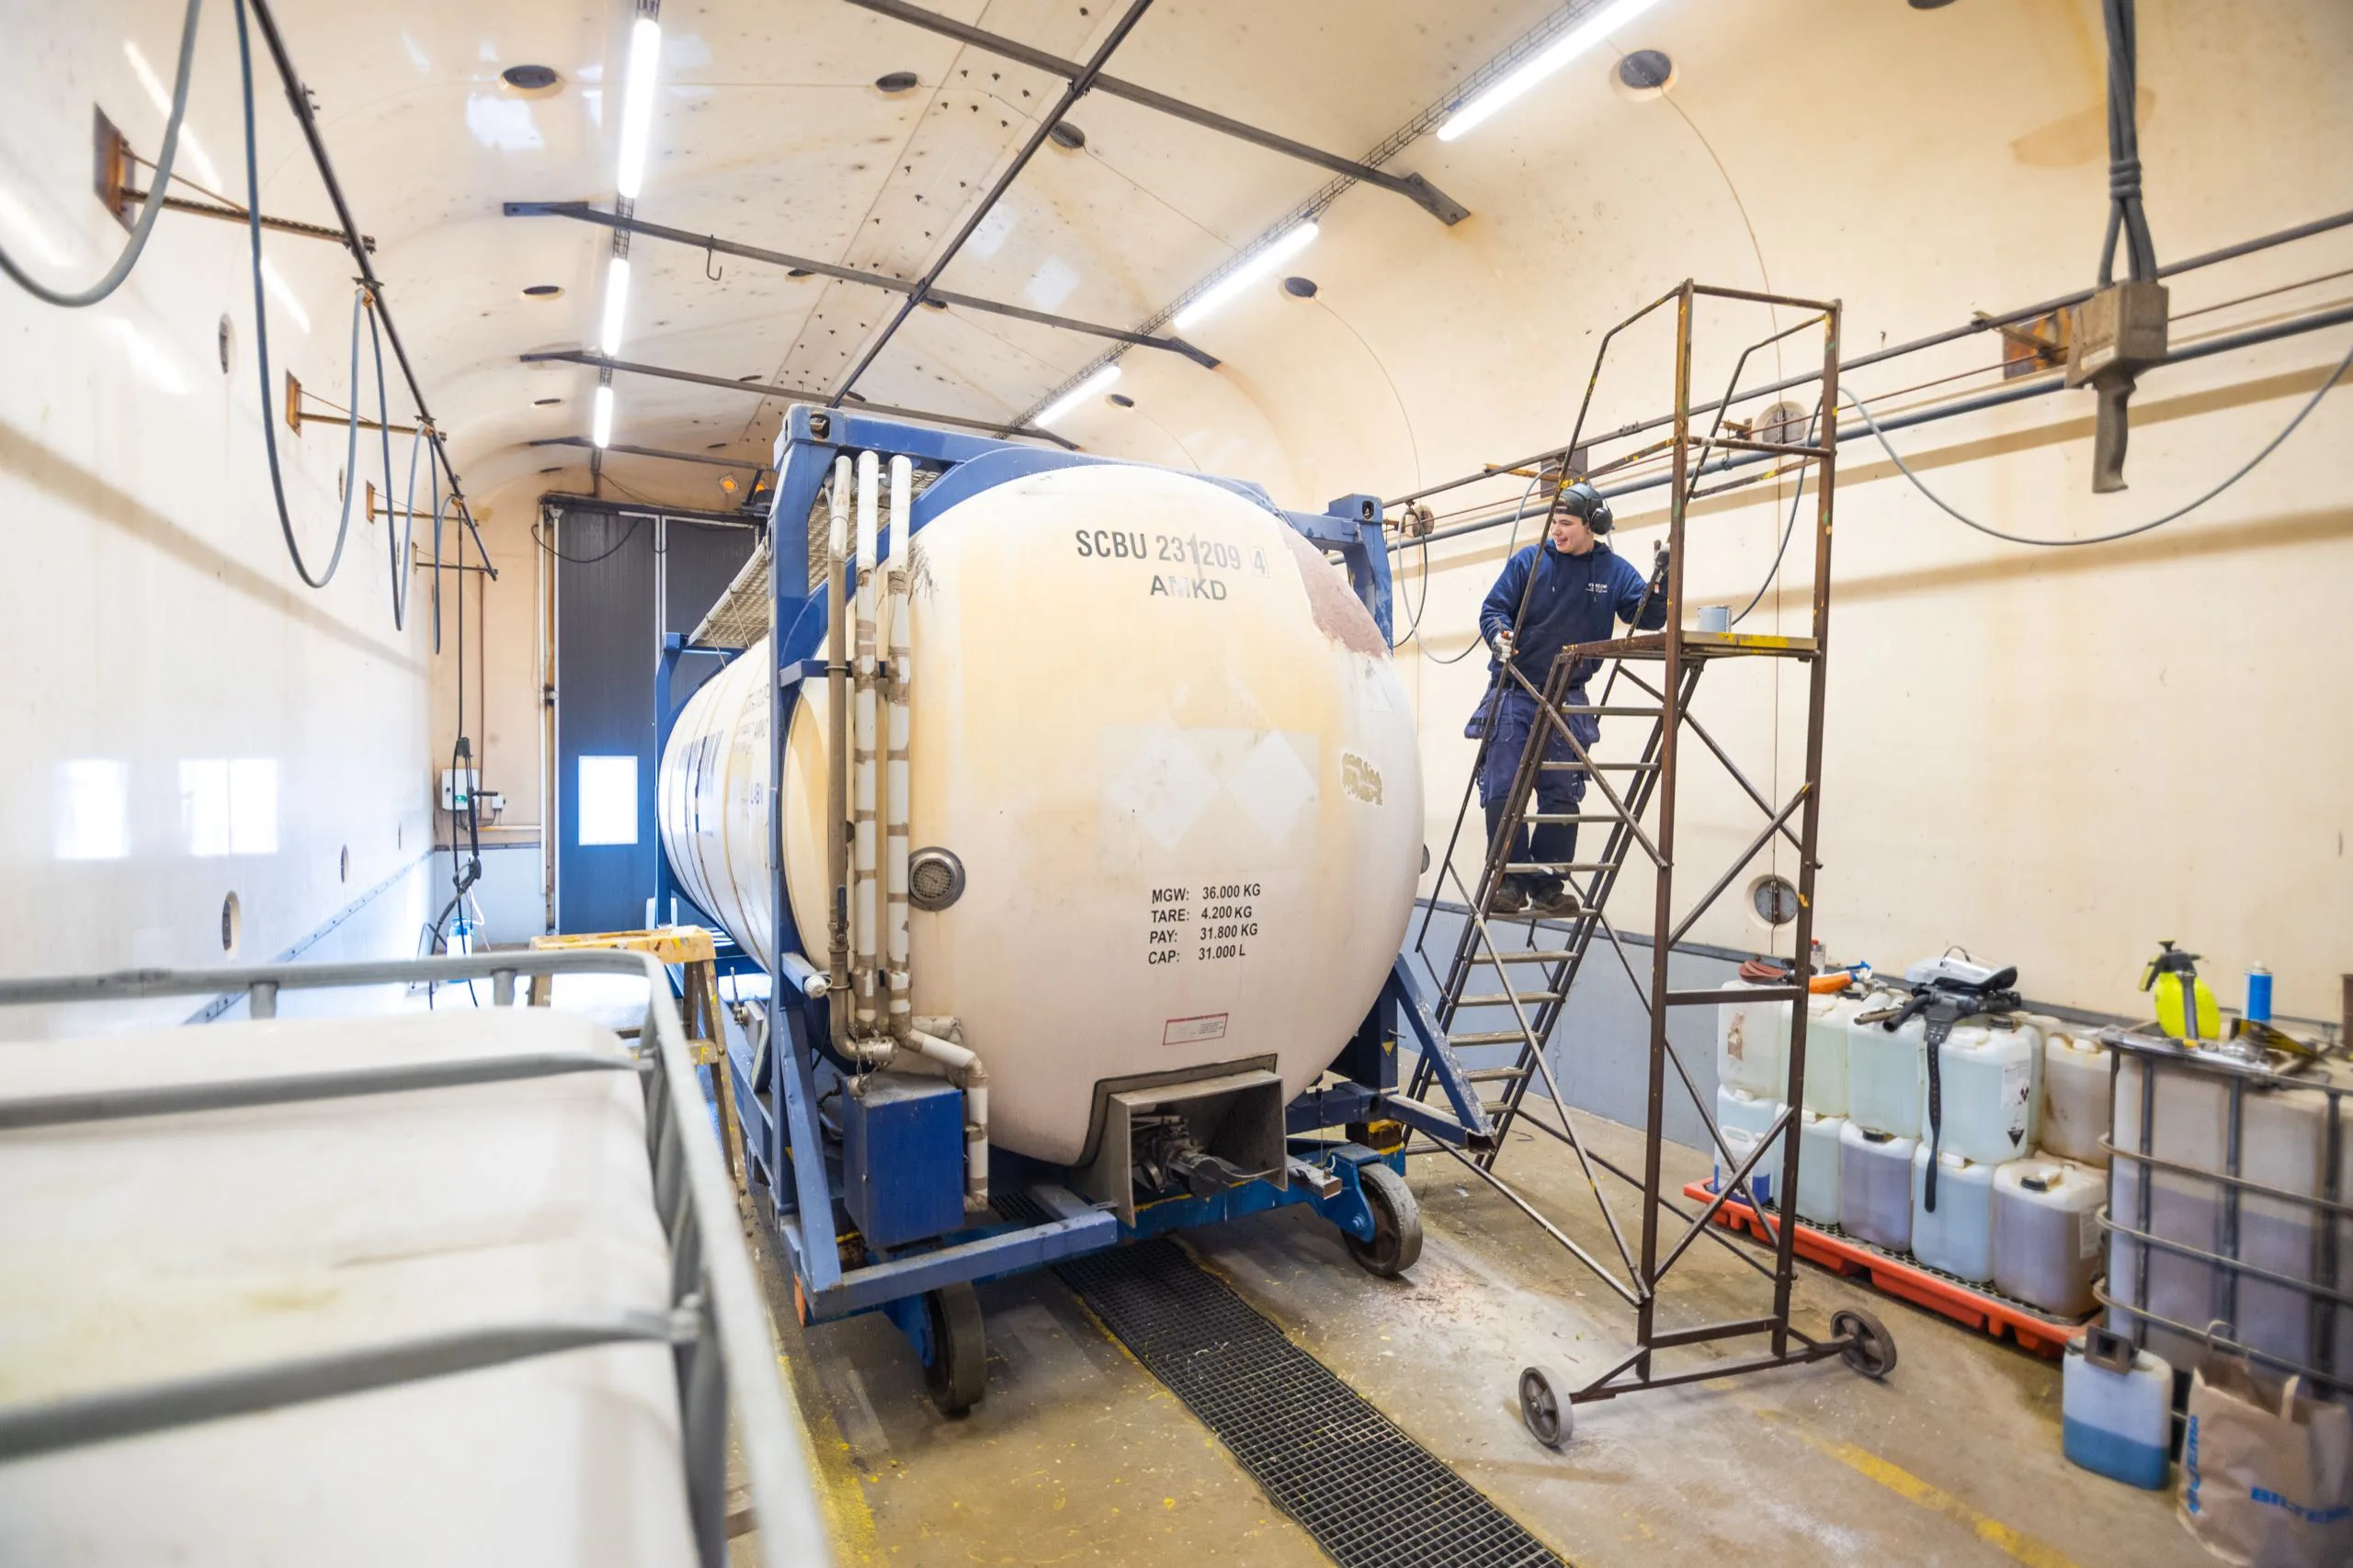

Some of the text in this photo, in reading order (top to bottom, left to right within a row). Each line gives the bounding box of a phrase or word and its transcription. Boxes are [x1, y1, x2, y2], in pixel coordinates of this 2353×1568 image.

[1075, 529, 1148, 560] SCBU
[1155, 534, 1242, 570] 231209
[1150, 574, 1227, 601] AMKD
[1152, 883, 1261, 904] MGW: 36.000 KG
[1151, 905, 1252, 924] TARE: 4.200 KG
[1149, 923, 1258, 944] PAY: 31.800 KG
[1148, 944, 1246, 965] CAP: 31.000 L
